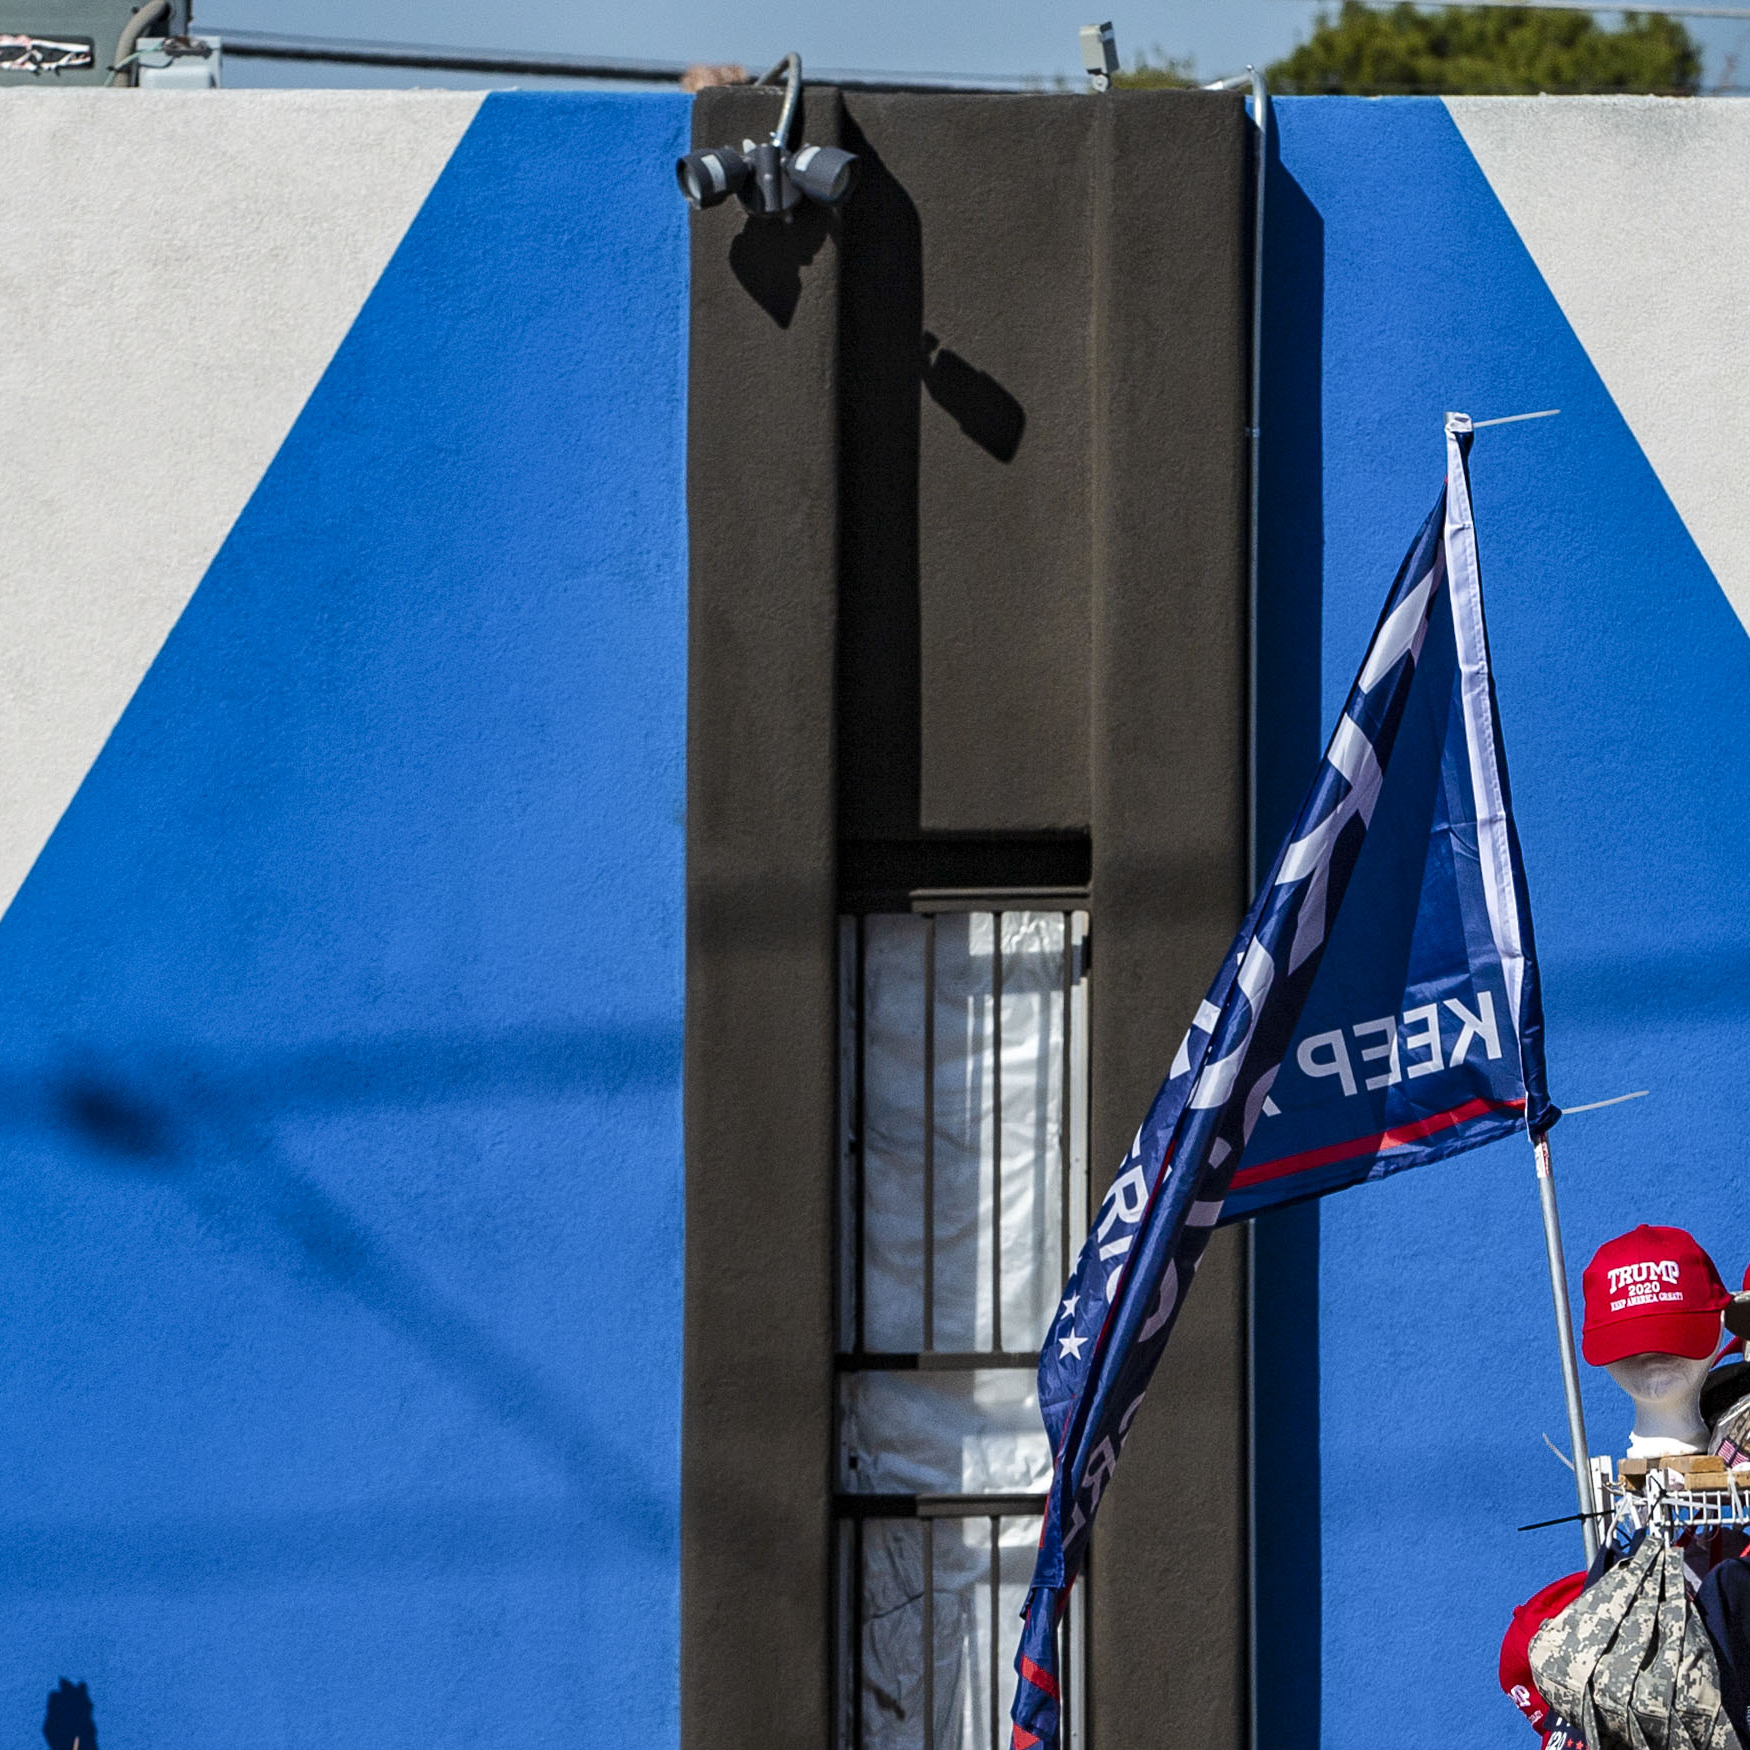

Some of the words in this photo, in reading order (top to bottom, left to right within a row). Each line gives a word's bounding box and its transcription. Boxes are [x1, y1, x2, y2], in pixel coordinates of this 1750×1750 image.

[1607, 1260, 1680, 1294] TRUMP
[1628, 1281, 1661, 1296] 2020
[1626, 1294, 1659, 1308] AMERICA
